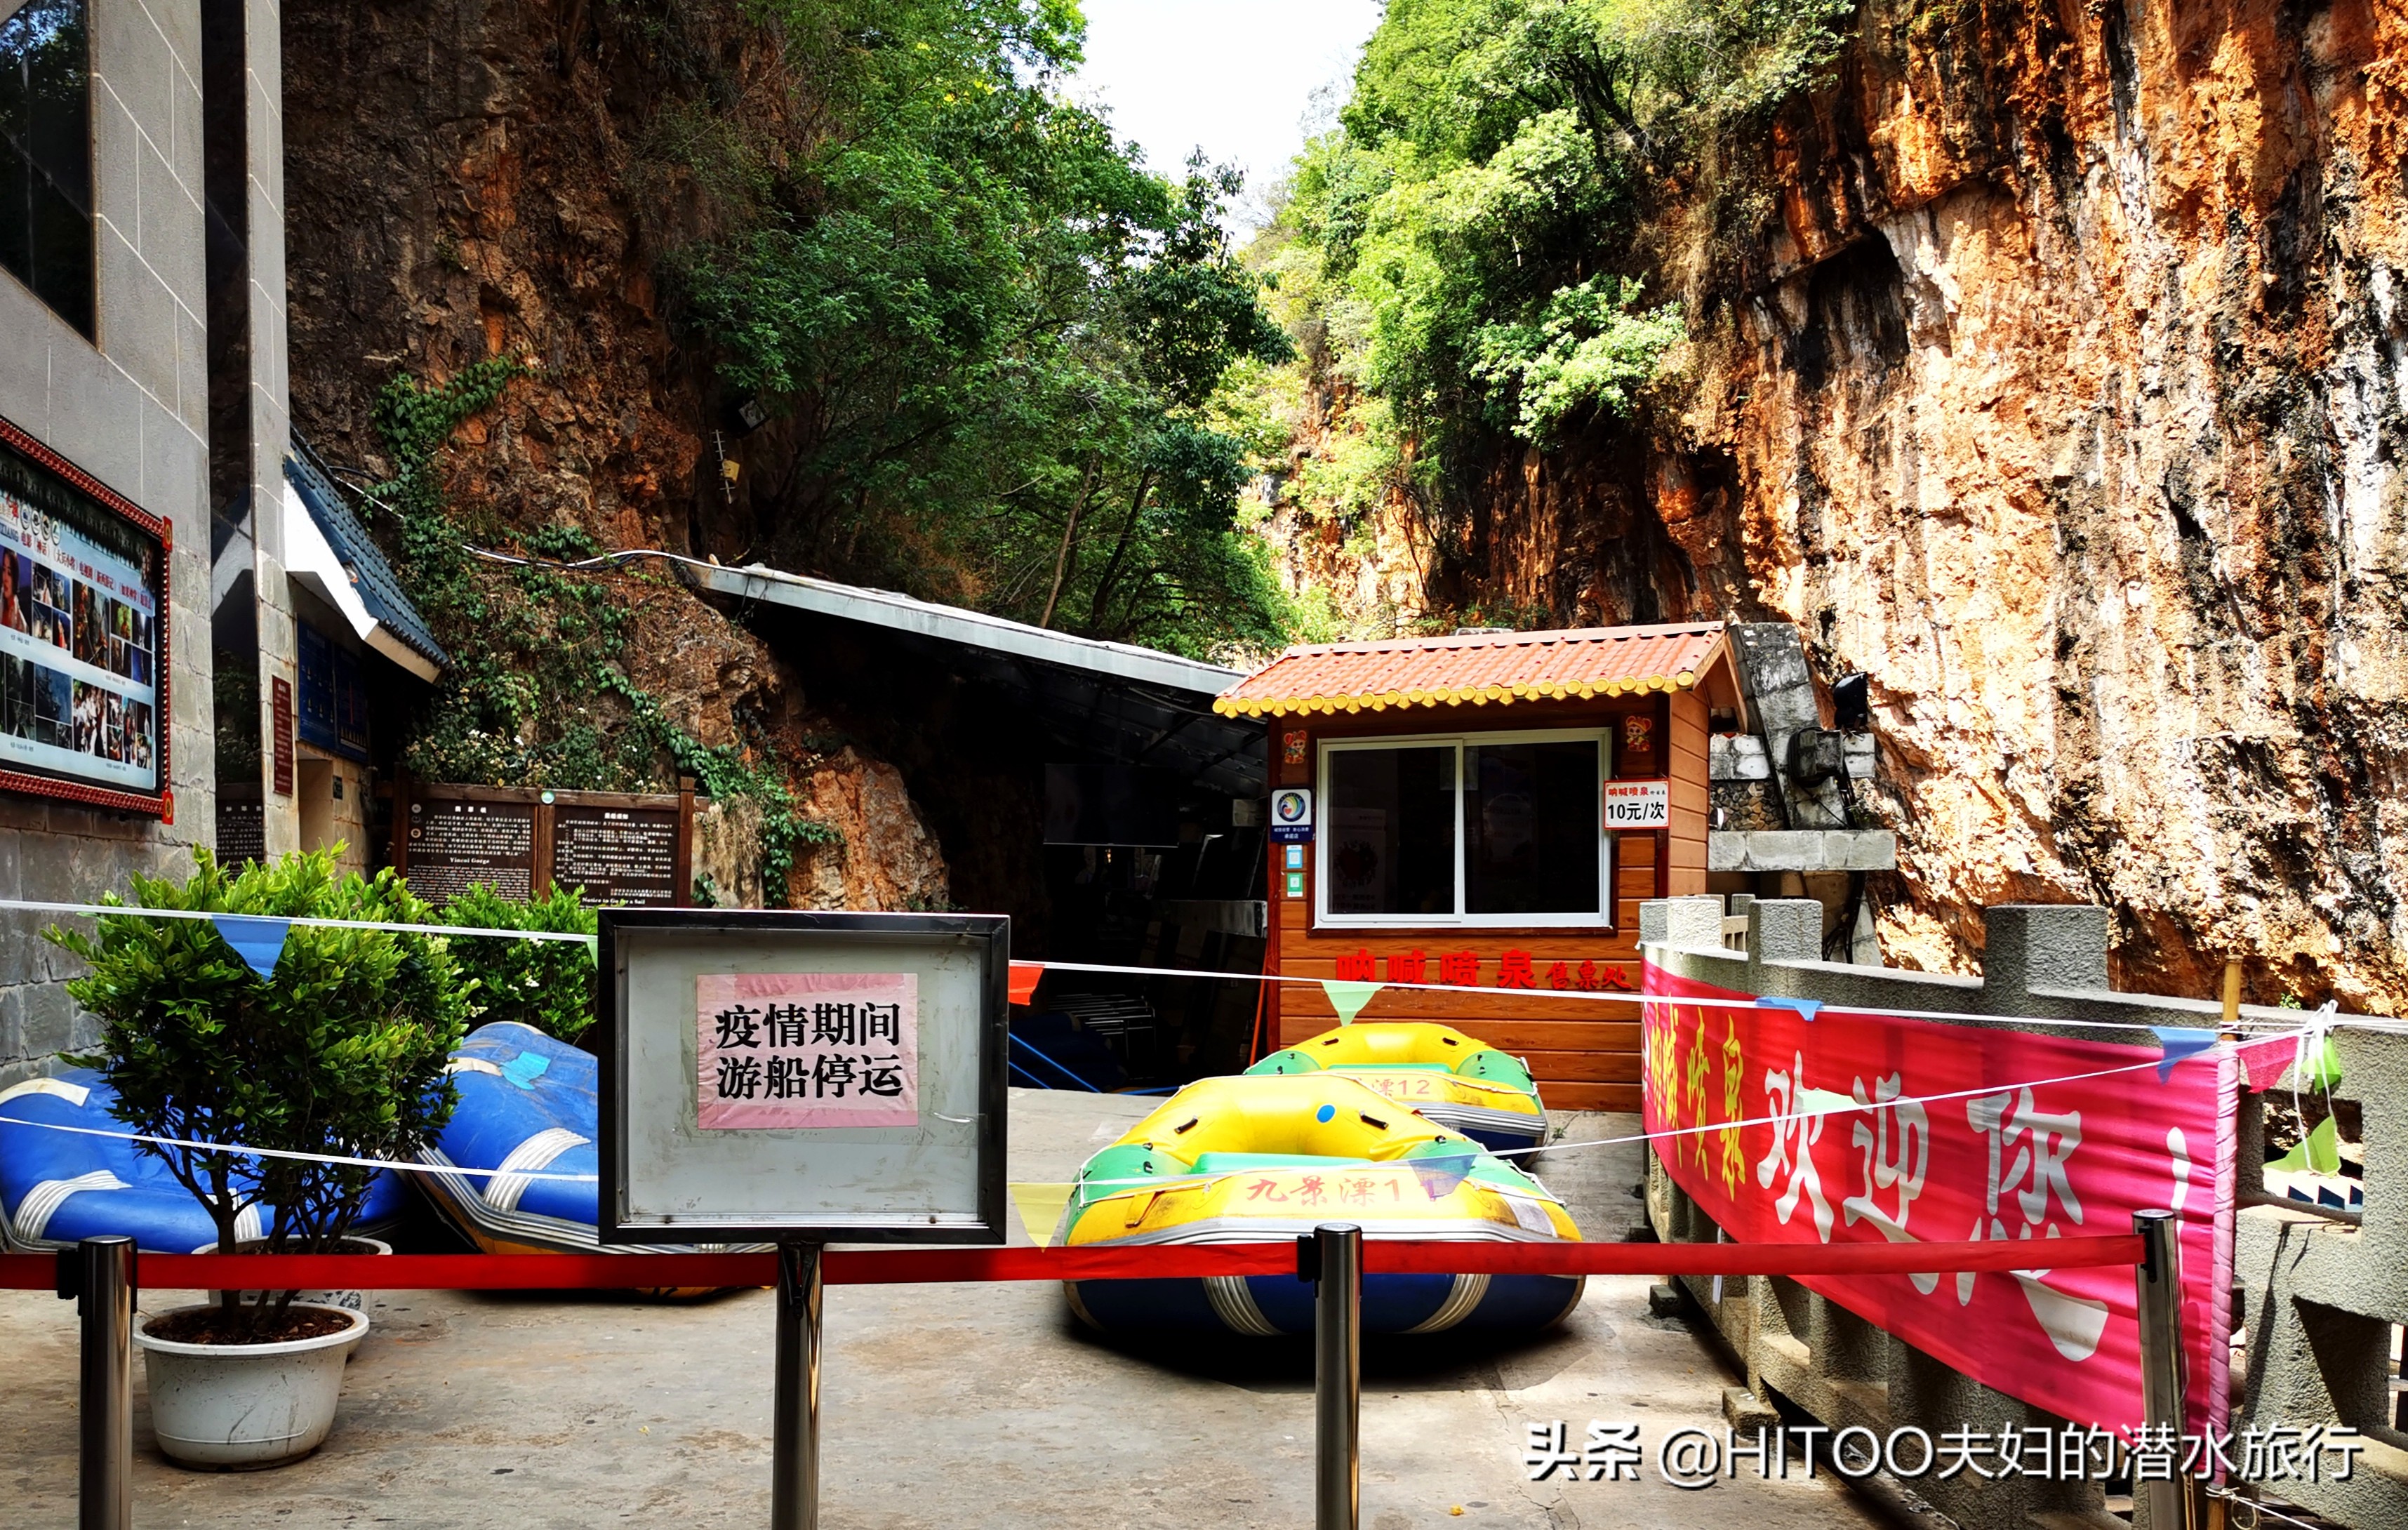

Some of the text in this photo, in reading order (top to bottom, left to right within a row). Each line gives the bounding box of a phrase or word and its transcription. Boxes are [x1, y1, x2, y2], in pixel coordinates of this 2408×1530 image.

[1609, 787, 1649, 797] 呐喊喷泉
[1608, 801, 1665, 820] 10元/次
[1336, 949, 1632, 990] 呐喊喷泉 售票处
[714, 1002, 900, 1049] 疫情期间
[717, 1053, 903, 1099] 游船停运
[1359, 1078, 1430, 1097] 漂12
